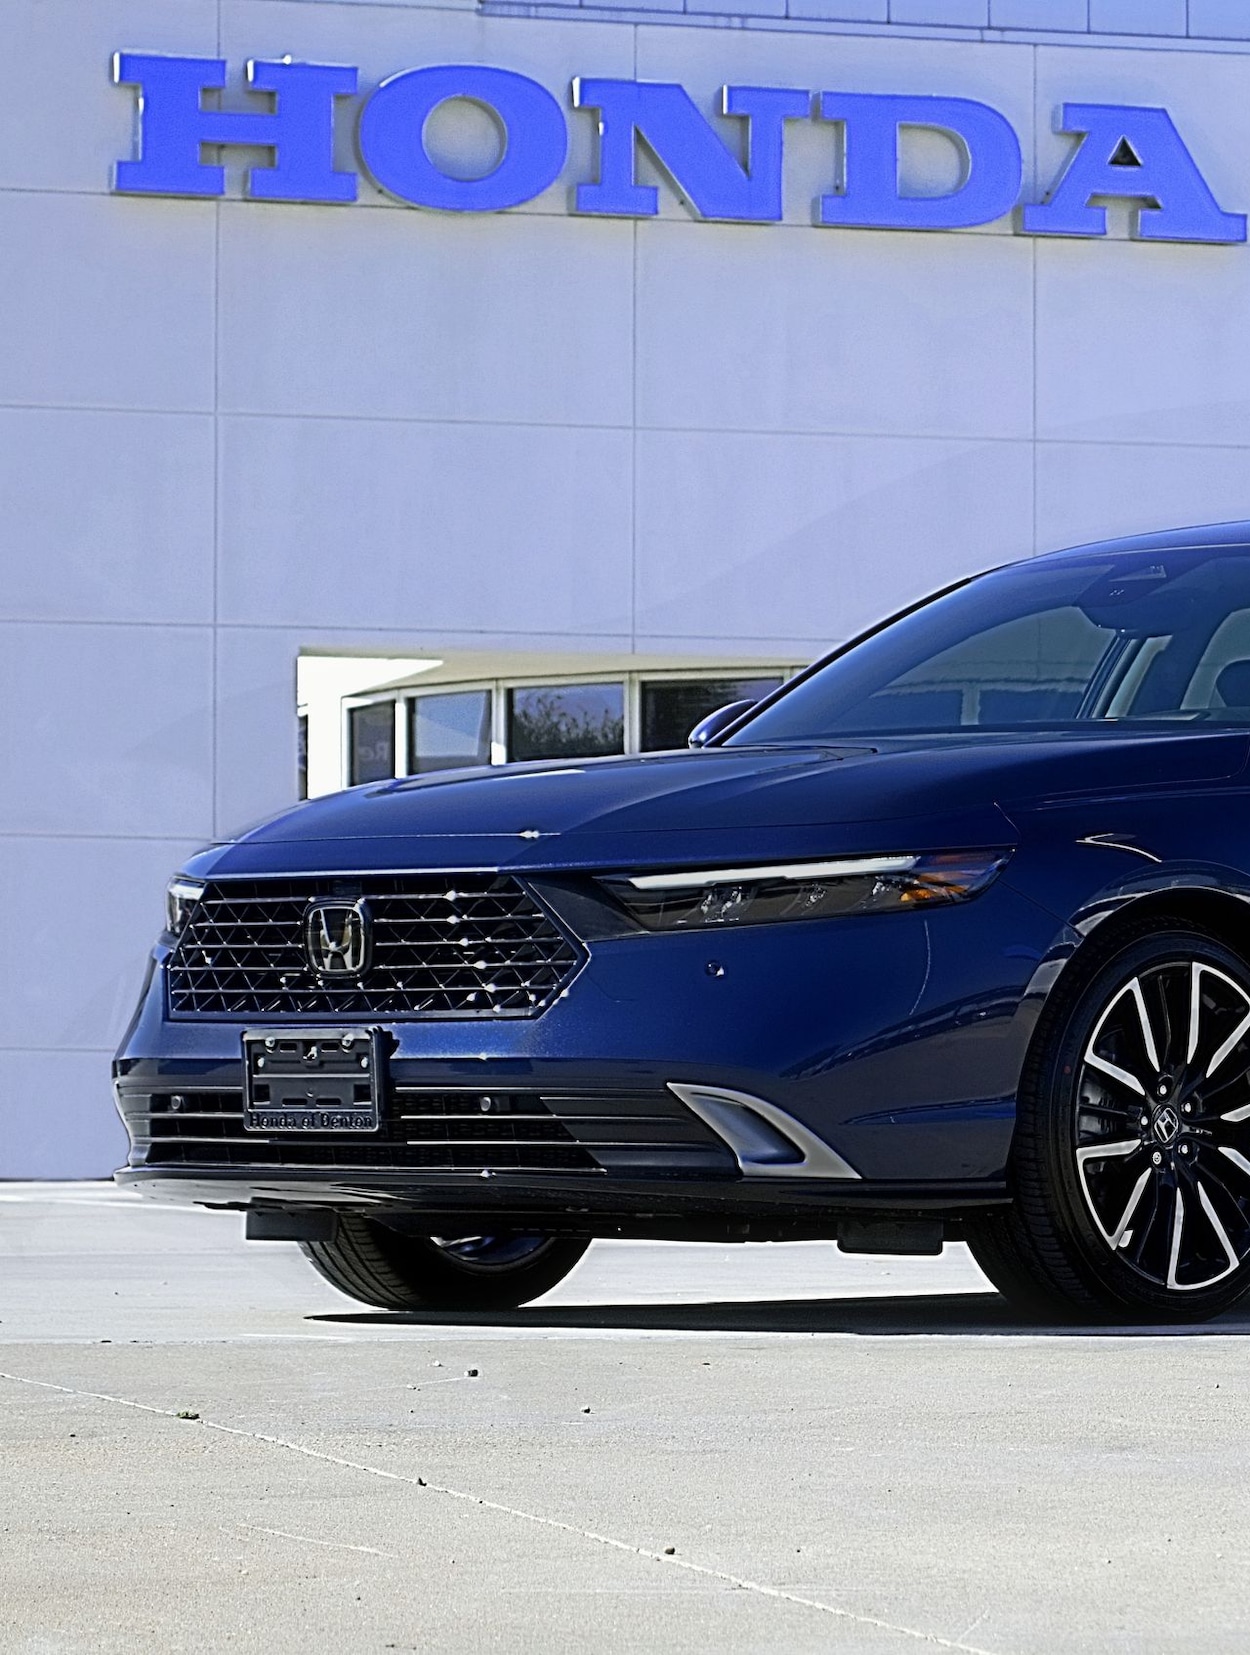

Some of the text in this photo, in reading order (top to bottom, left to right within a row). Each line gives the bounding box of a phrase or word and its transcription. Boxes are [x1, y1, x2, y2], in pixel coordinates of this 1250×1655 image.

[113, 52, 1248, 242] HONDA
[249, 1112, 373, 1128] Honda of Denton
